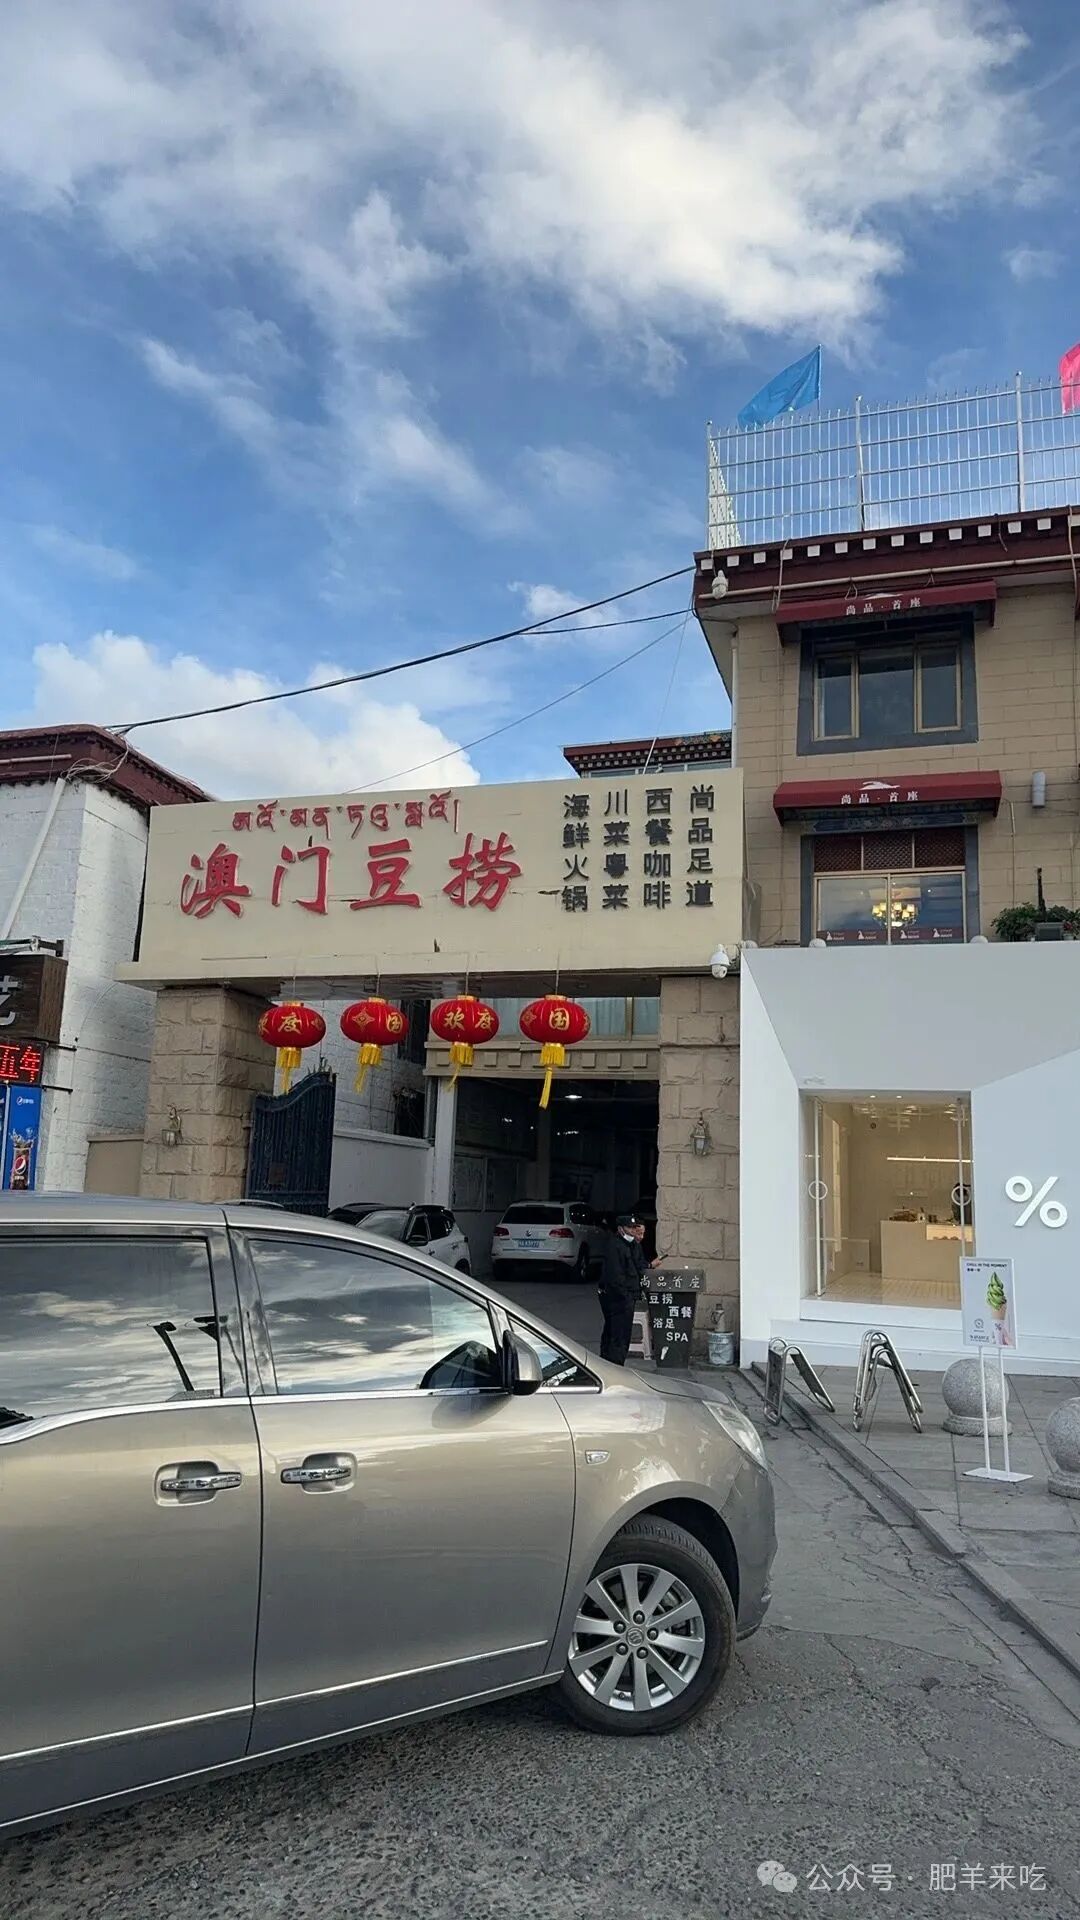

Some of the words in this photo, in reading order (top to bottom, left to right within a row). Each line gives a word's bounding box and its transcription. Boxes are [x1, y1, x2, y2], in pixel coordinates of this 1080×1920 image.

[180, 832, 521, 919] 澳门豆捞
[561, 794, 590, 912] 海鲜火锅
[602, 789, 630, 910] 川菜粤菜
[643, 788, 673, 909] 西餐咖啡
[685, 784, 715, 907] 尚品足道
[666, 1332, 689, 1342] SPA
[668, 1306, 692, 1318] 西餐
